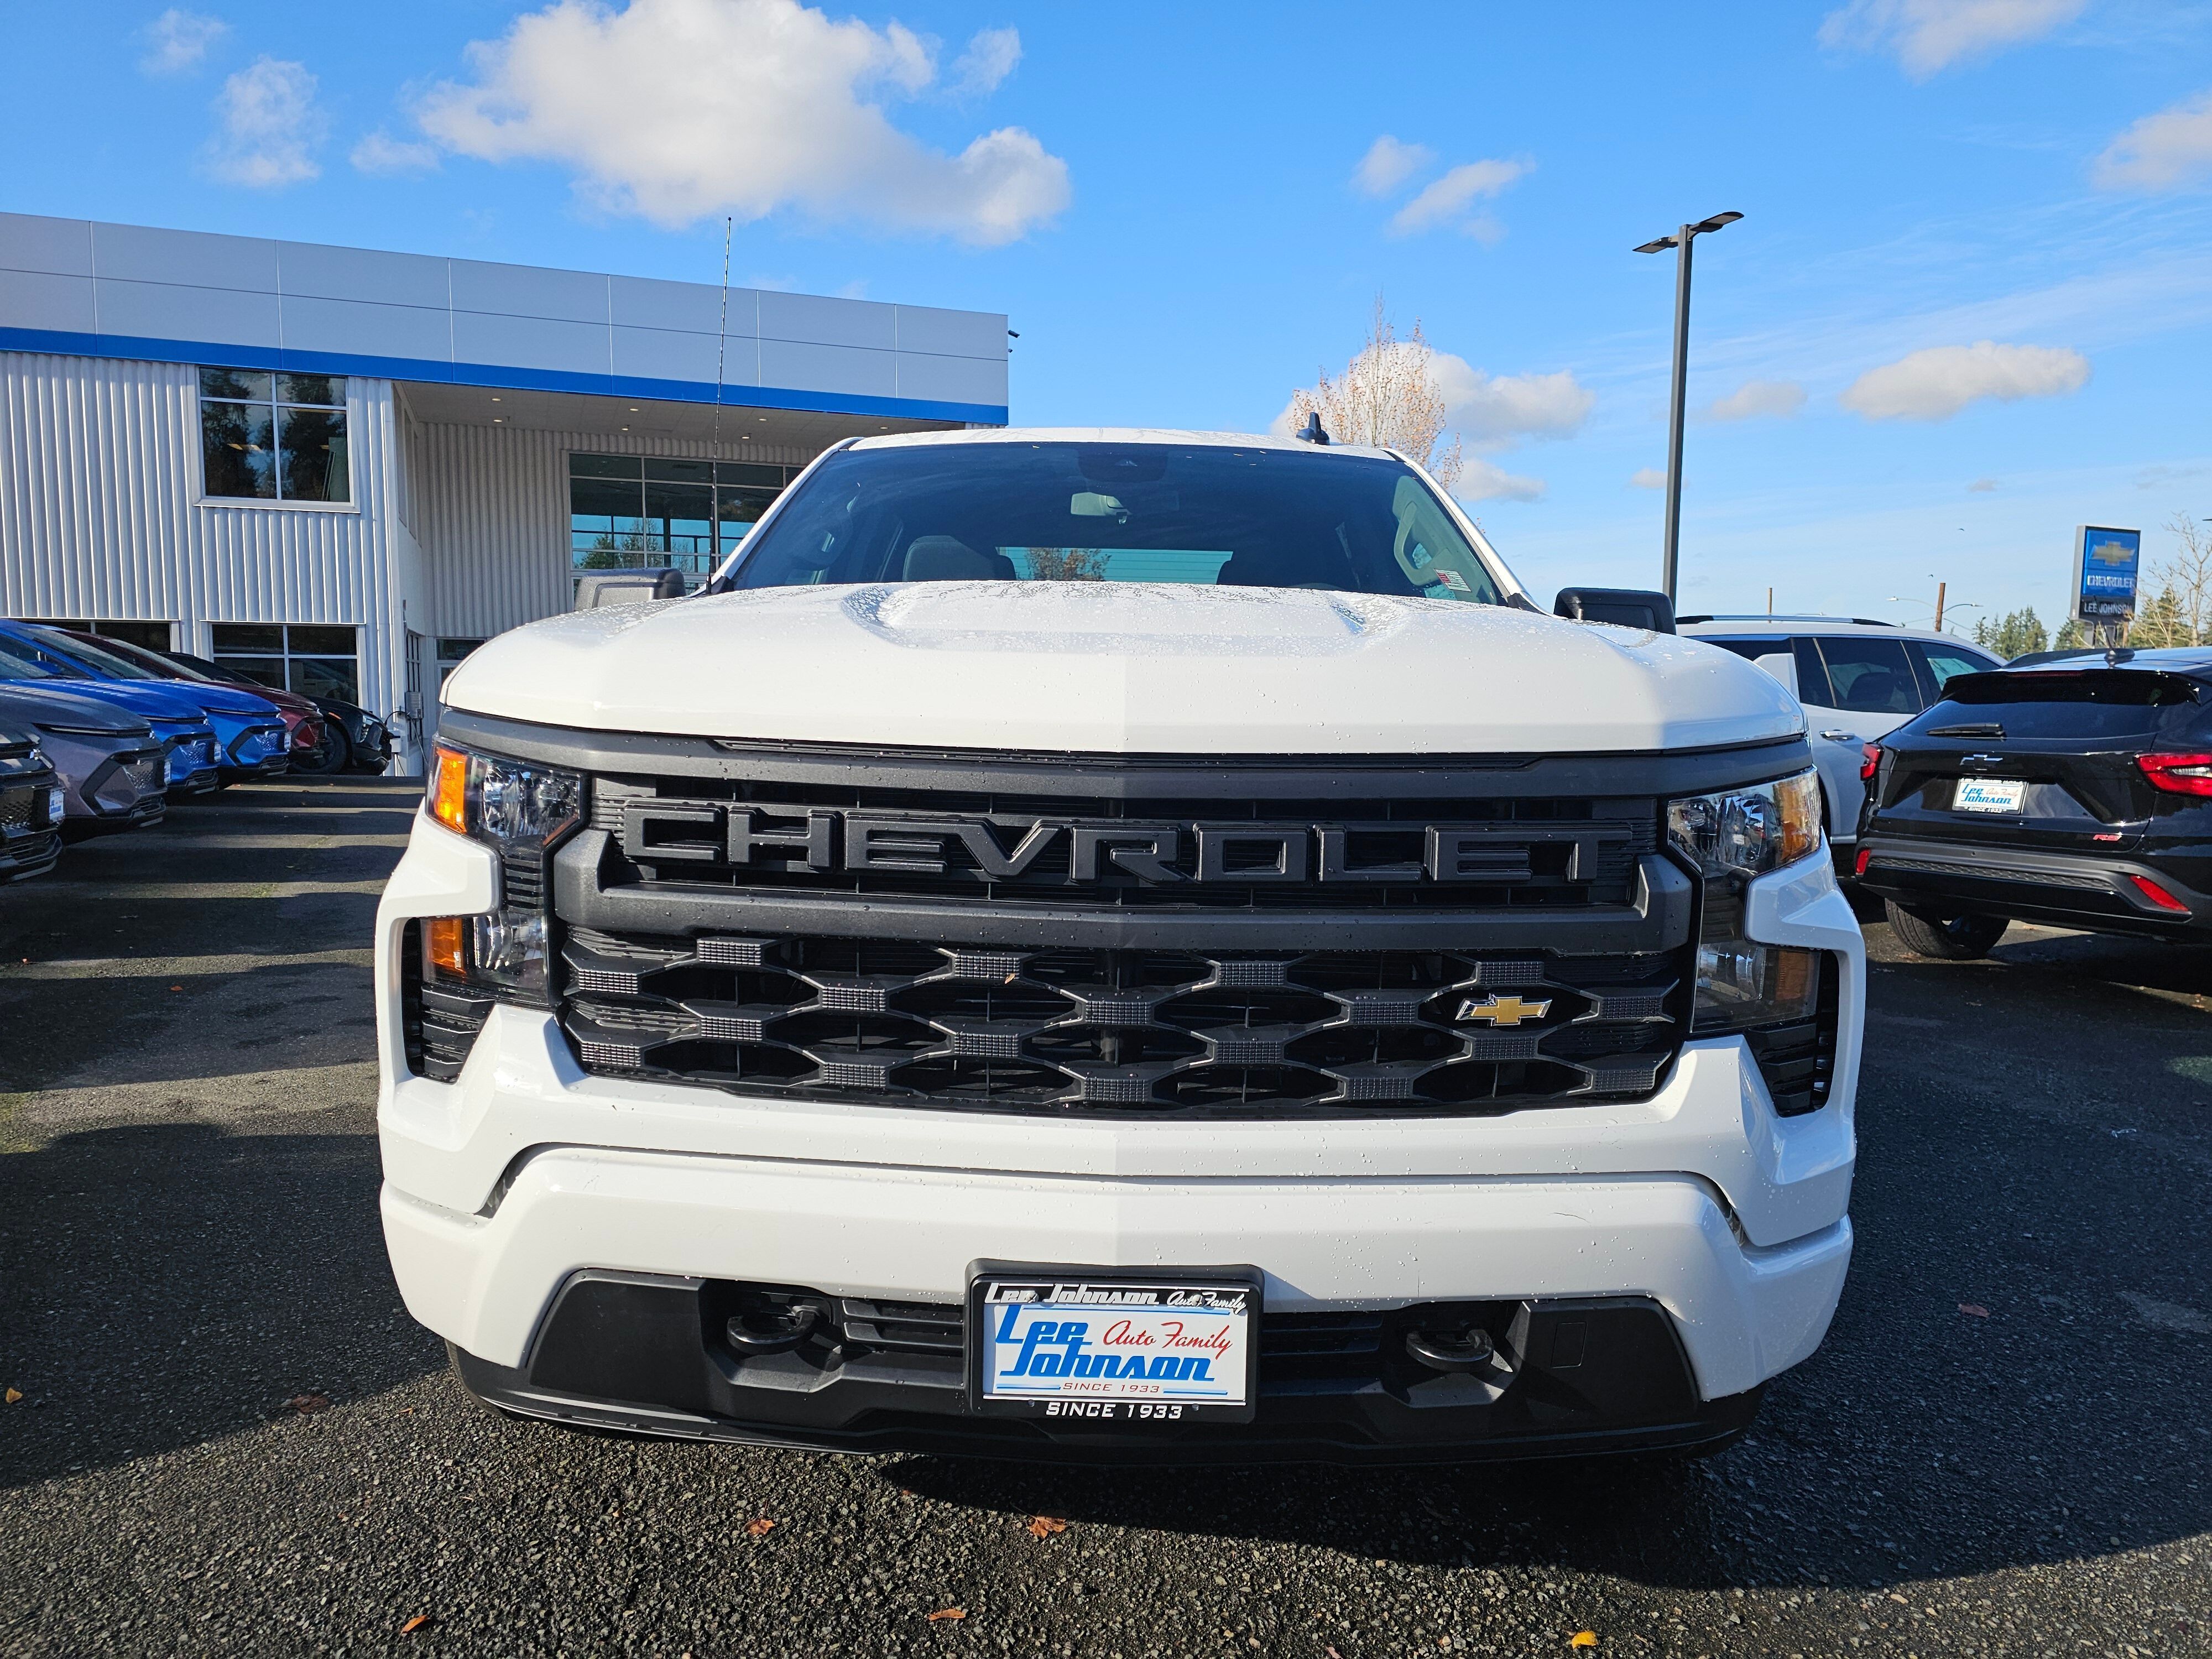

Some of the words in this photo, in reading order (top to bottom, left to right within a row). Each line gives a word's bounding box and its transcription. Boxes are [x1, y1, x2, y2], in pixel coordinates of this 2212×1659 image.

[2087, 575, 2135, 588] CHEVROLET
[2084, 602, 2098, 613] LEE
[1961, 784, 1984, 795] Lee
[1960, 794, 2013, 805] Johnson
[624, 801, 1632, 883] CHEVROLET
[1044, 1283, 1160, 1305] Johnson
[1167, 1291, 1202, 1307] Aut
[1202, 1292, 1246, 1314] Family
[995, 1305, 1093, 1345] Lee
[1103, 1320, 1156, 1346] Auto
[1161, 1322, 1233, 1360] Family
[999, 1340, 1215, 1381] Johnson
[1063, 1383, 1113, 1391] SINCE
[1121, 1384, 1160, 1393] 1933
[1046, 1402, 1117, 1417] SINCE
[1128, 1404, 1183, 1419] 1933
